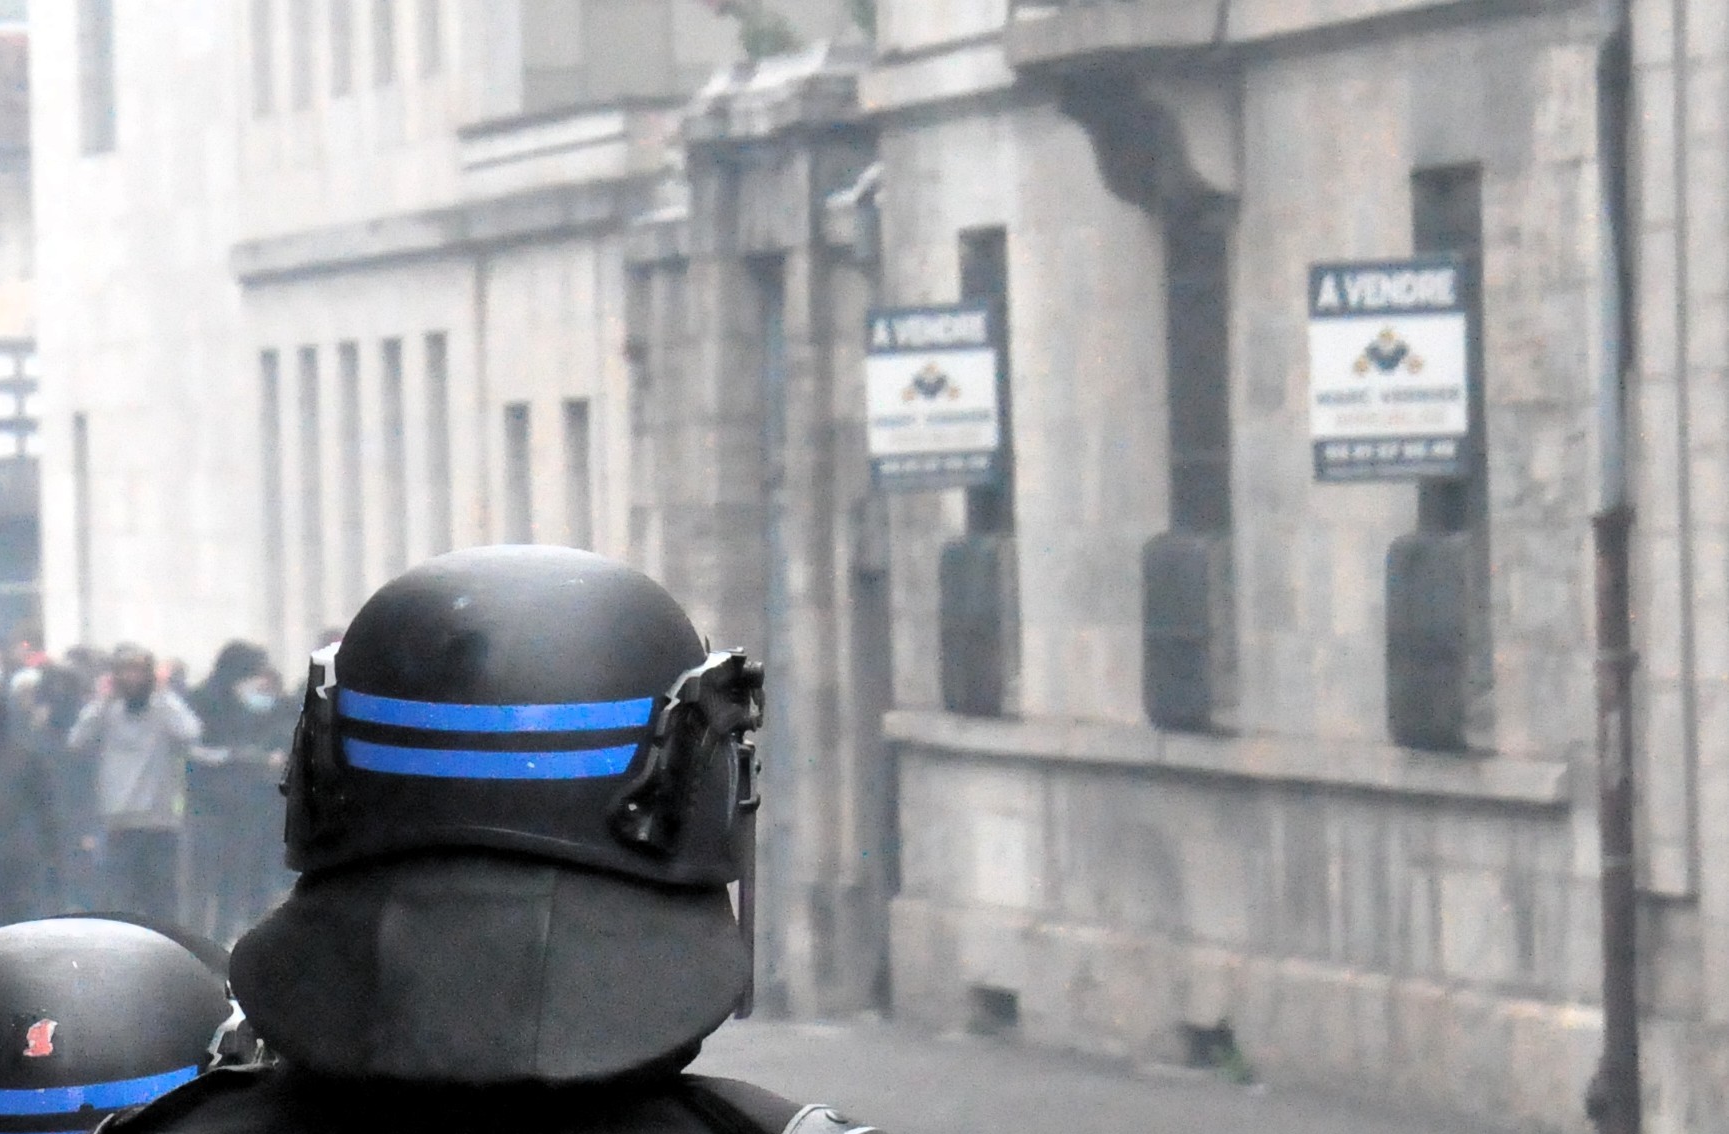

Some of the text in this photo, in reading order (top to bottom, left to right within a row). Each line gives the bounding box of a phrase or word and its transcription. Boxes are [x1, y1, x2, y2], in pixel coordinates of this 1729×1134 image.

[1317, 269, 1457, 307] A VENDRE
[872, 311, 988, 347] A VENDRE
